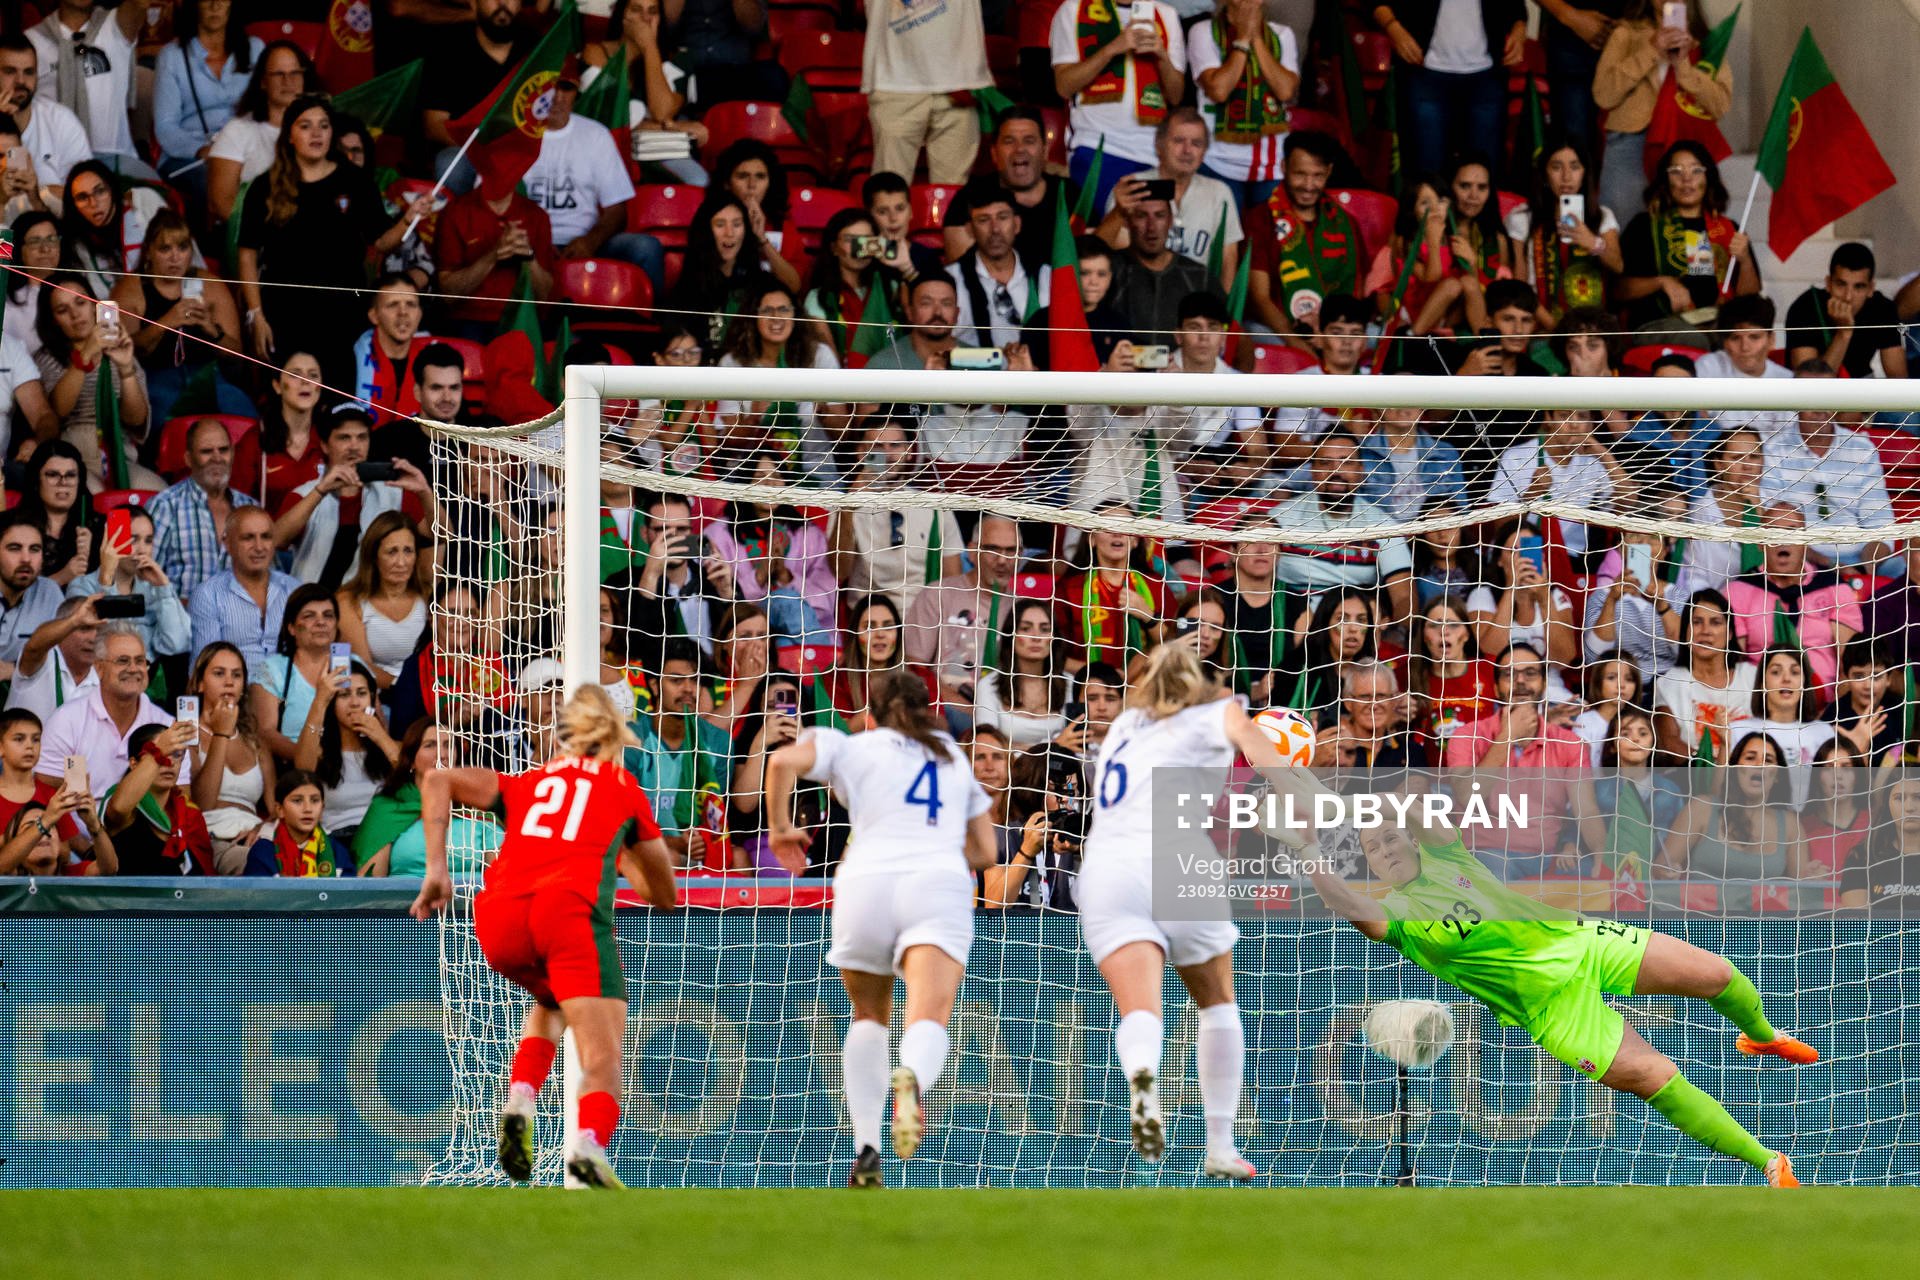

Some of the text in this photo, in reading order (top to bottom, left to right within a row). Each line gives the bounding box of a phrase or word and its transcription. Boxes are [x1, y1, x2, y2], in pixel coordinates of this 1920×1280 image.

[904, 760, 943, 826] 4
[1100, 738, 1128, 809] 6
[521, 776, 593, 842] 21
[1442, 901, 1482, 941] 23
